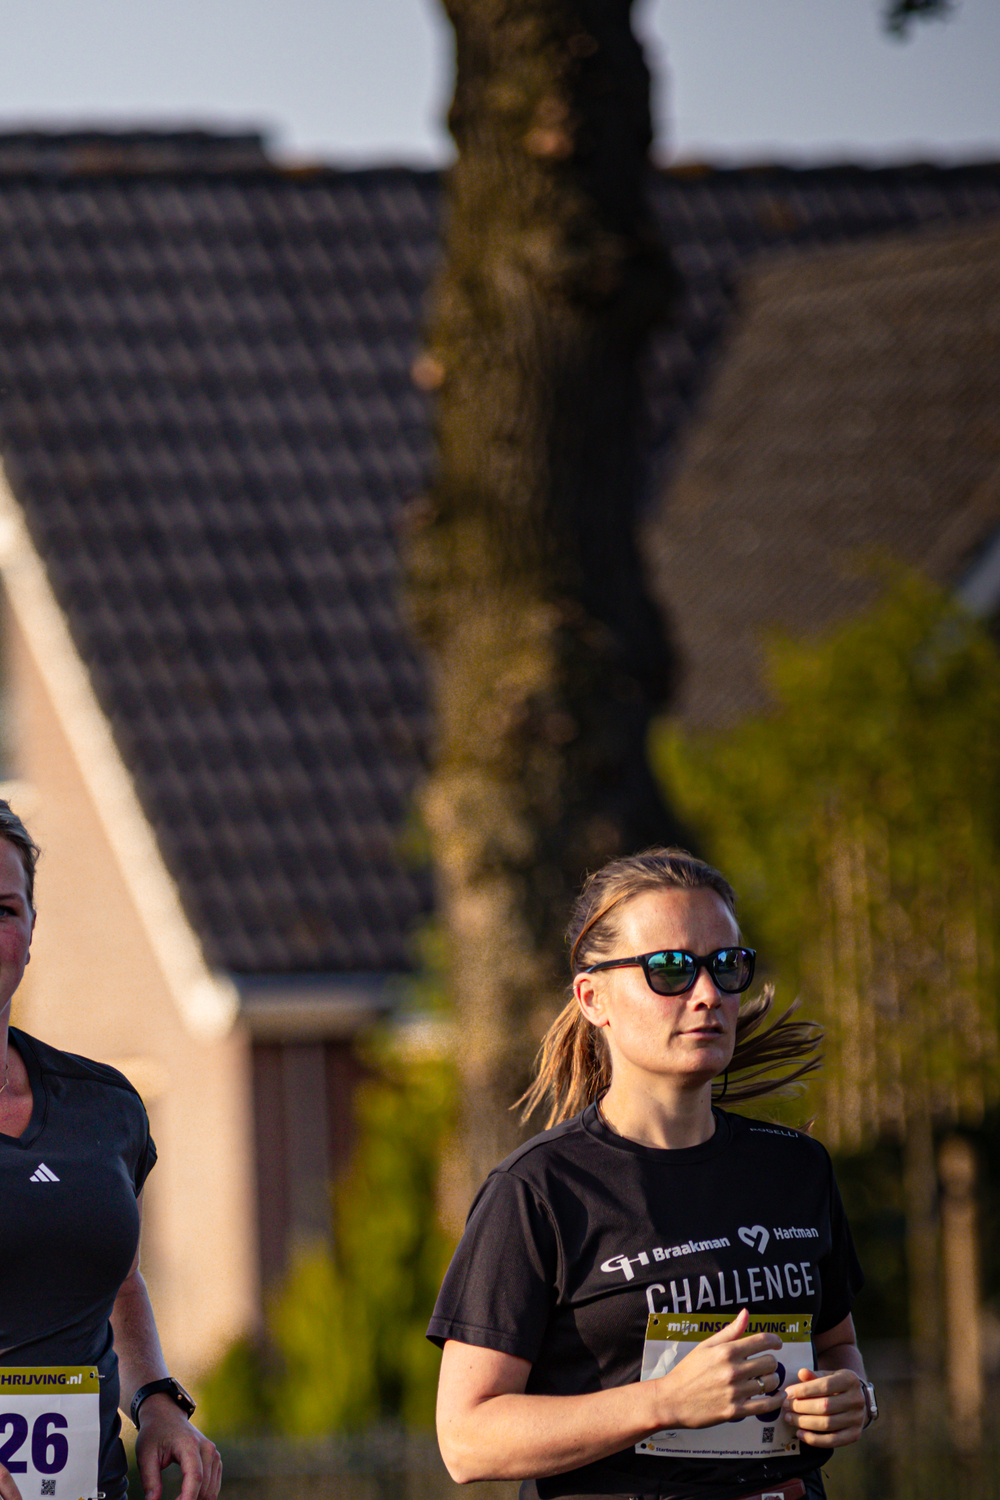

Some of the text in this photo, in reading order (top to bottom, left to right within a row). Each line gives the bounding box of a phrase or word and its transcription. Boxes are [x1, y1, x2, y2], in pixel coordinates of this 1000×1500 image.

[652, 1236, 731, 1262] Braakman
[773, 1226, 819, 1240] Hartman
[645, 1262, 815, 1314] CHALLENGE
[667, 1320, 800, 1335] mijnINSIJVING.nl
